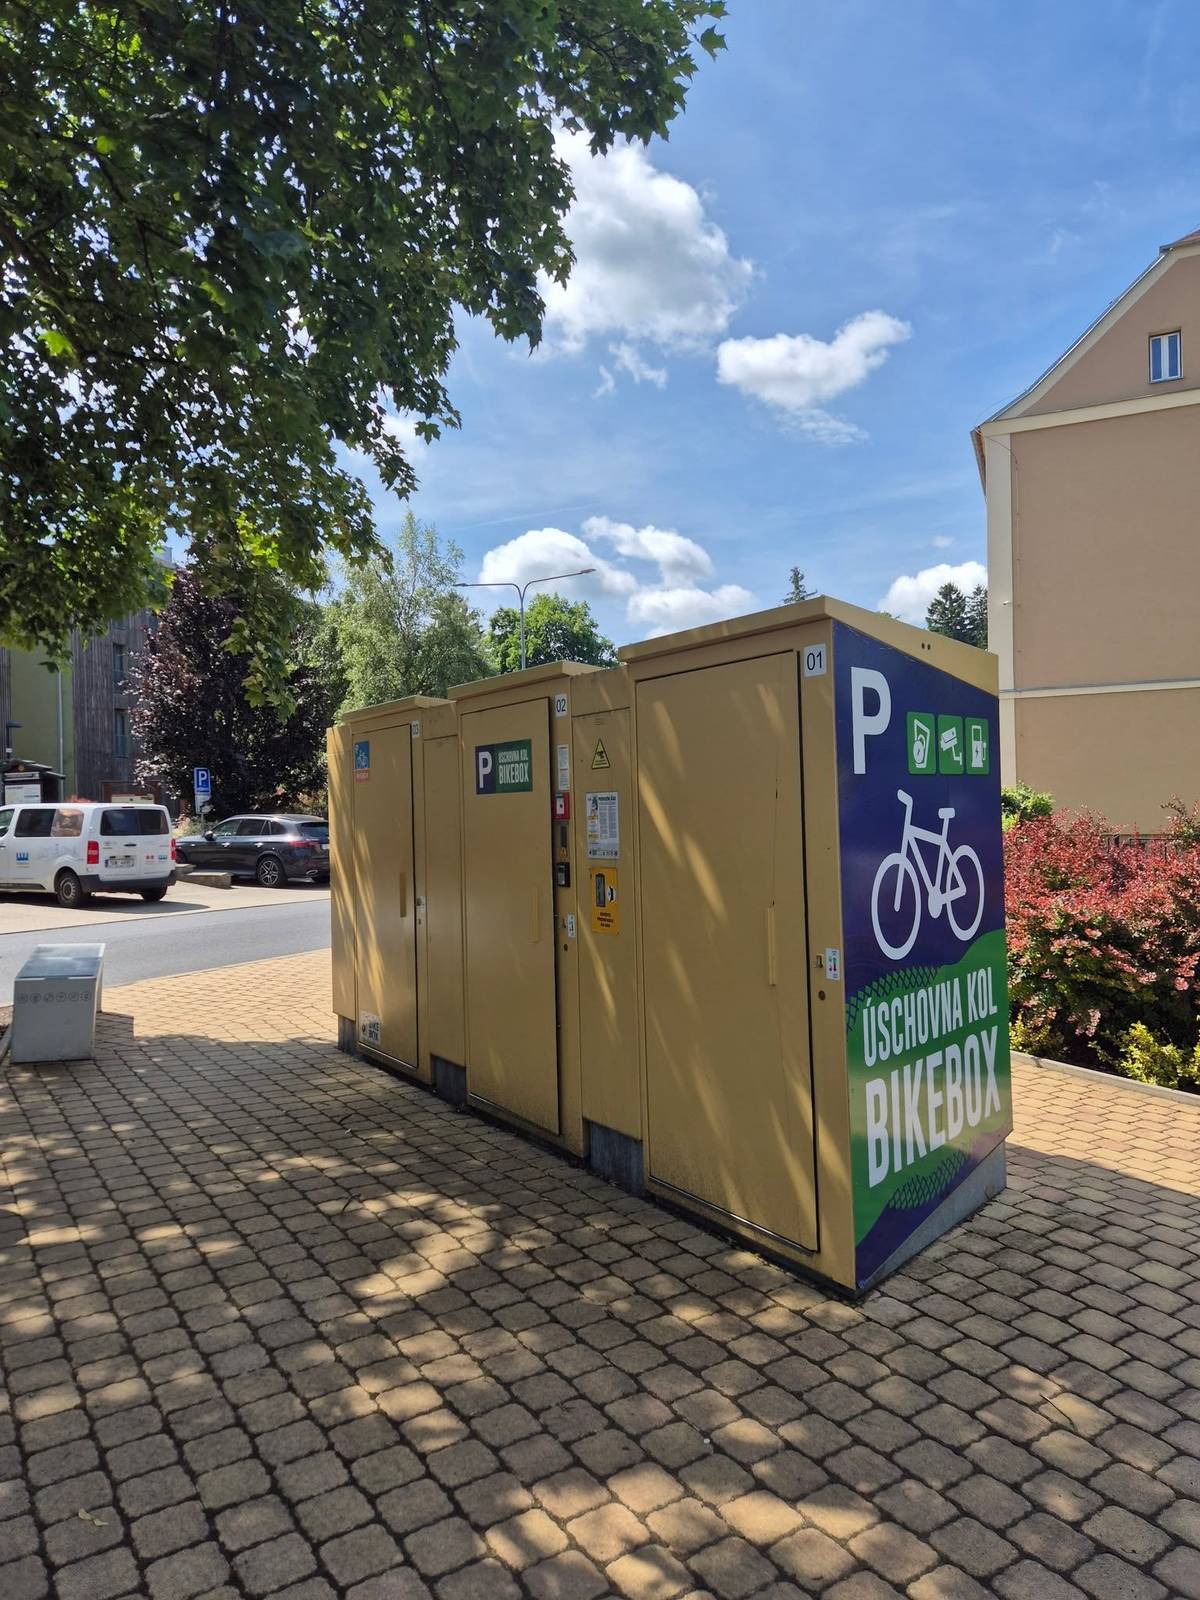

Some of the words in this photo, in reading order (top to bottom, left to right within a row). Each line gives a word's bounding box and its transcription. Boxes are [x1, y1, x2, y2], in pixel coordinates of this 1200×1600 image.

[806, 650, 822, 671] 01
[556, 698, 566, 713] 02
[851, 666, 892, 775] P
[198, 770, 208, 786] P
[478, 751, 493, 789] P
[498, 762, 529, 785] BIKEBOX
[862, 977, 964, 1068] ÚSCHOVNA
[966, 966, 998, 1026] KOL
[865, 1024, 1001, 1189] BIKEBOX
